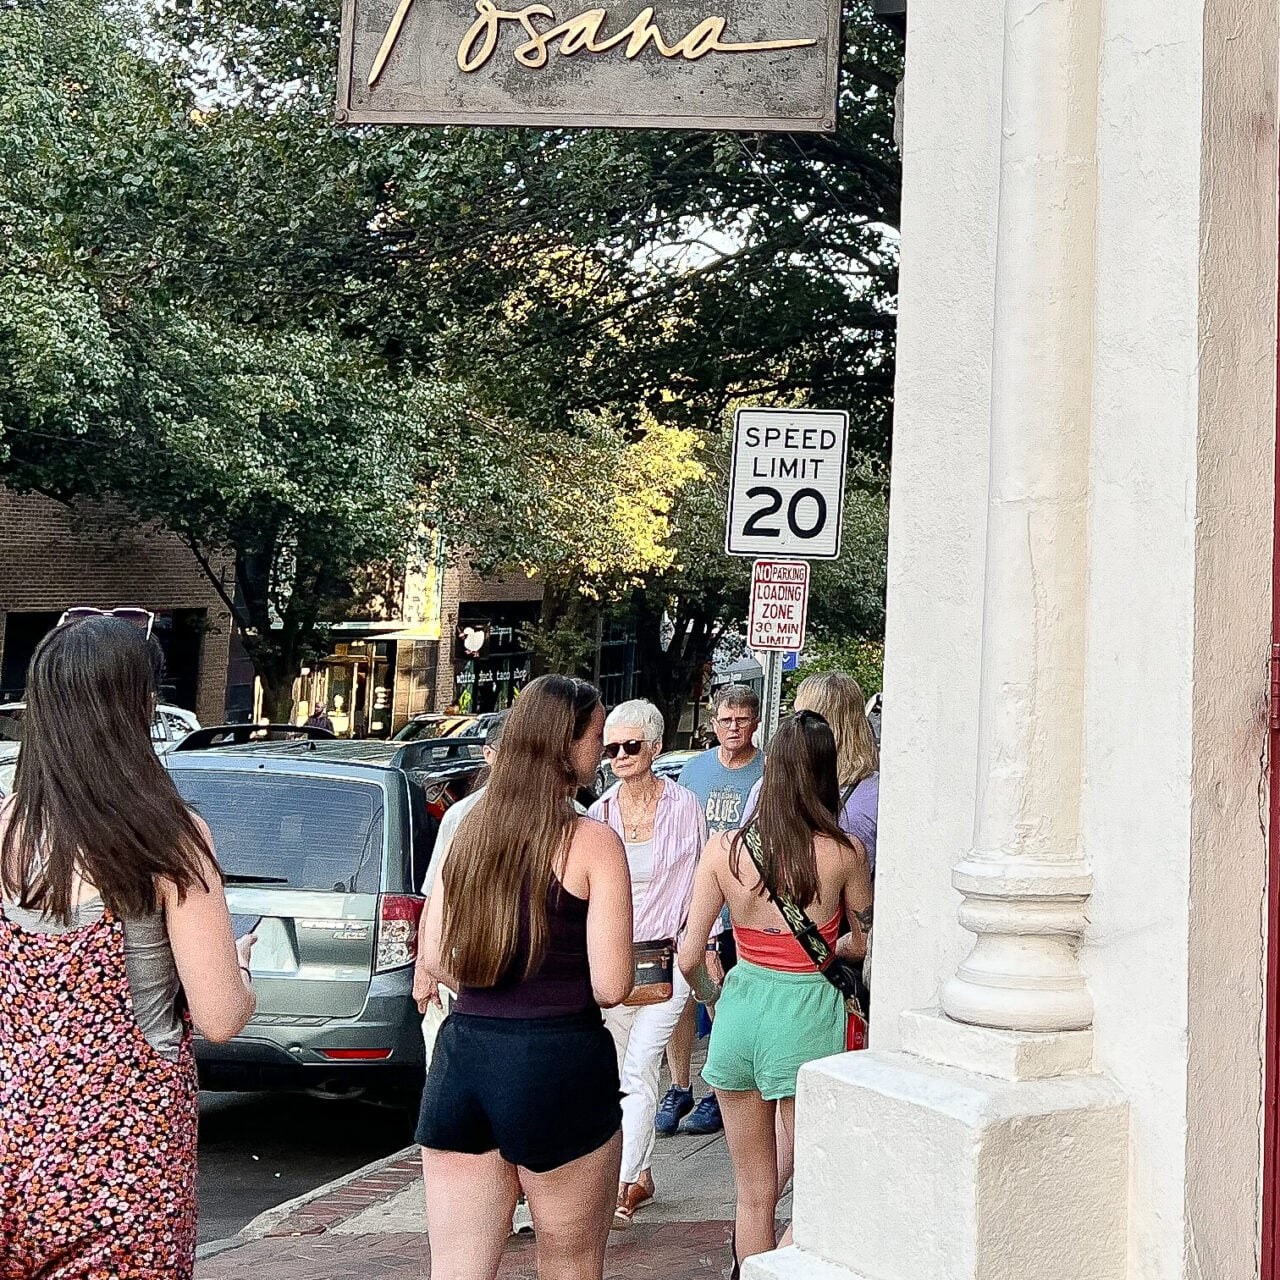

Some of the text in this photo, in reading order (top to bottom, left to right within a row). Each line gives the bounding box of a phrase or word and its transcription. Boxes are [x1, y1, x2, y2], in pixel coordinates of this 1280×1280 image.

[745, 427, 836, 450] SPEED
[753, 457, 824, 479] LIMIT
[742, 486, 827, 539] 20
[755, 565, 805, 581] NO PARKING
[757, 585, 802, 601] LOADING
[762, 603, 794, 620] ZONE
[755, 622, 799, 634] 30 MIN
[759, 635, 793, 645] LIMIT
[705, 798, 741, 823] BLUES
